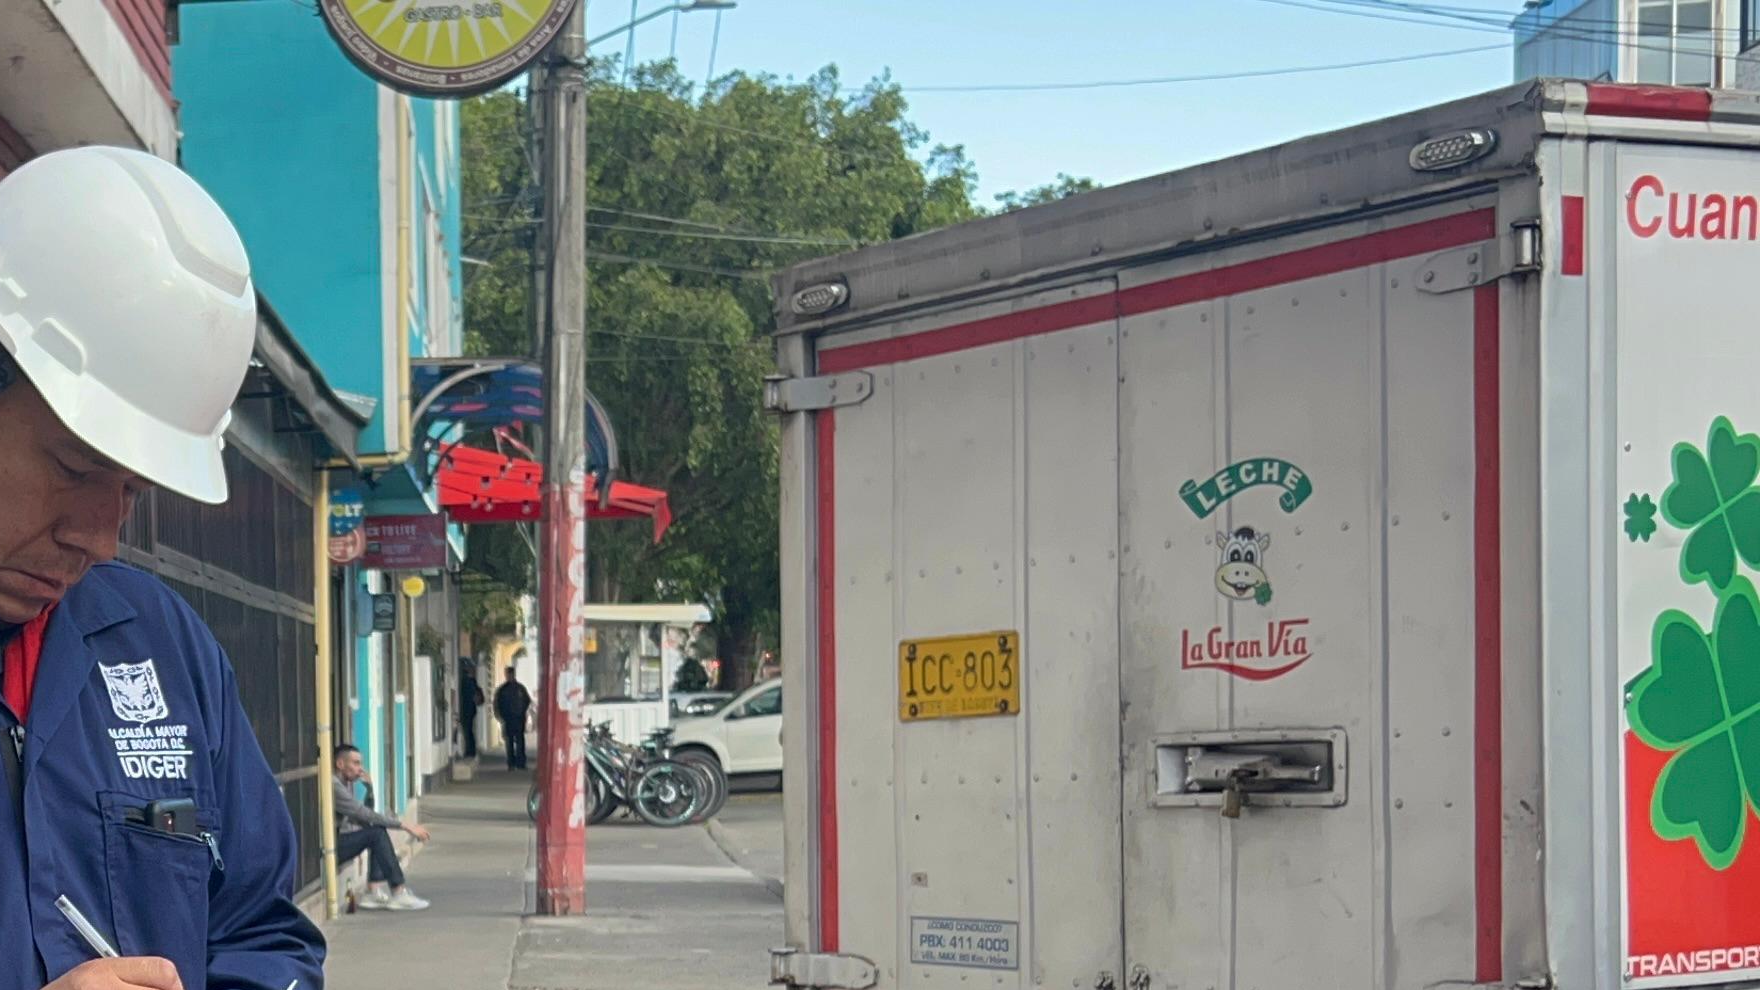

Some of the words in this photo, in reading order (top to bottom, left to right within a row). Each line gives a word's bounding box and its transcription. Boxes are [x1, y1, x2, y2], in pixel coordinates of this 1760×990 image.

[1196, 460, 1303, 512] LECHE
[1181, 629, 1204, 671] La
[1207, 626, 1263, 661] Gran
[1268, 617, 1311, 658] Vía
[155, 725, 188, 738] MAYOR
[115, 739, 129, 751] DE
[119, 755, 187, 780] IDIGER
[949, 936, 972, 950] 411
[976, 938, 1009, 953] 4003
[1628, 946, 1760, 976] TRANSPOR
